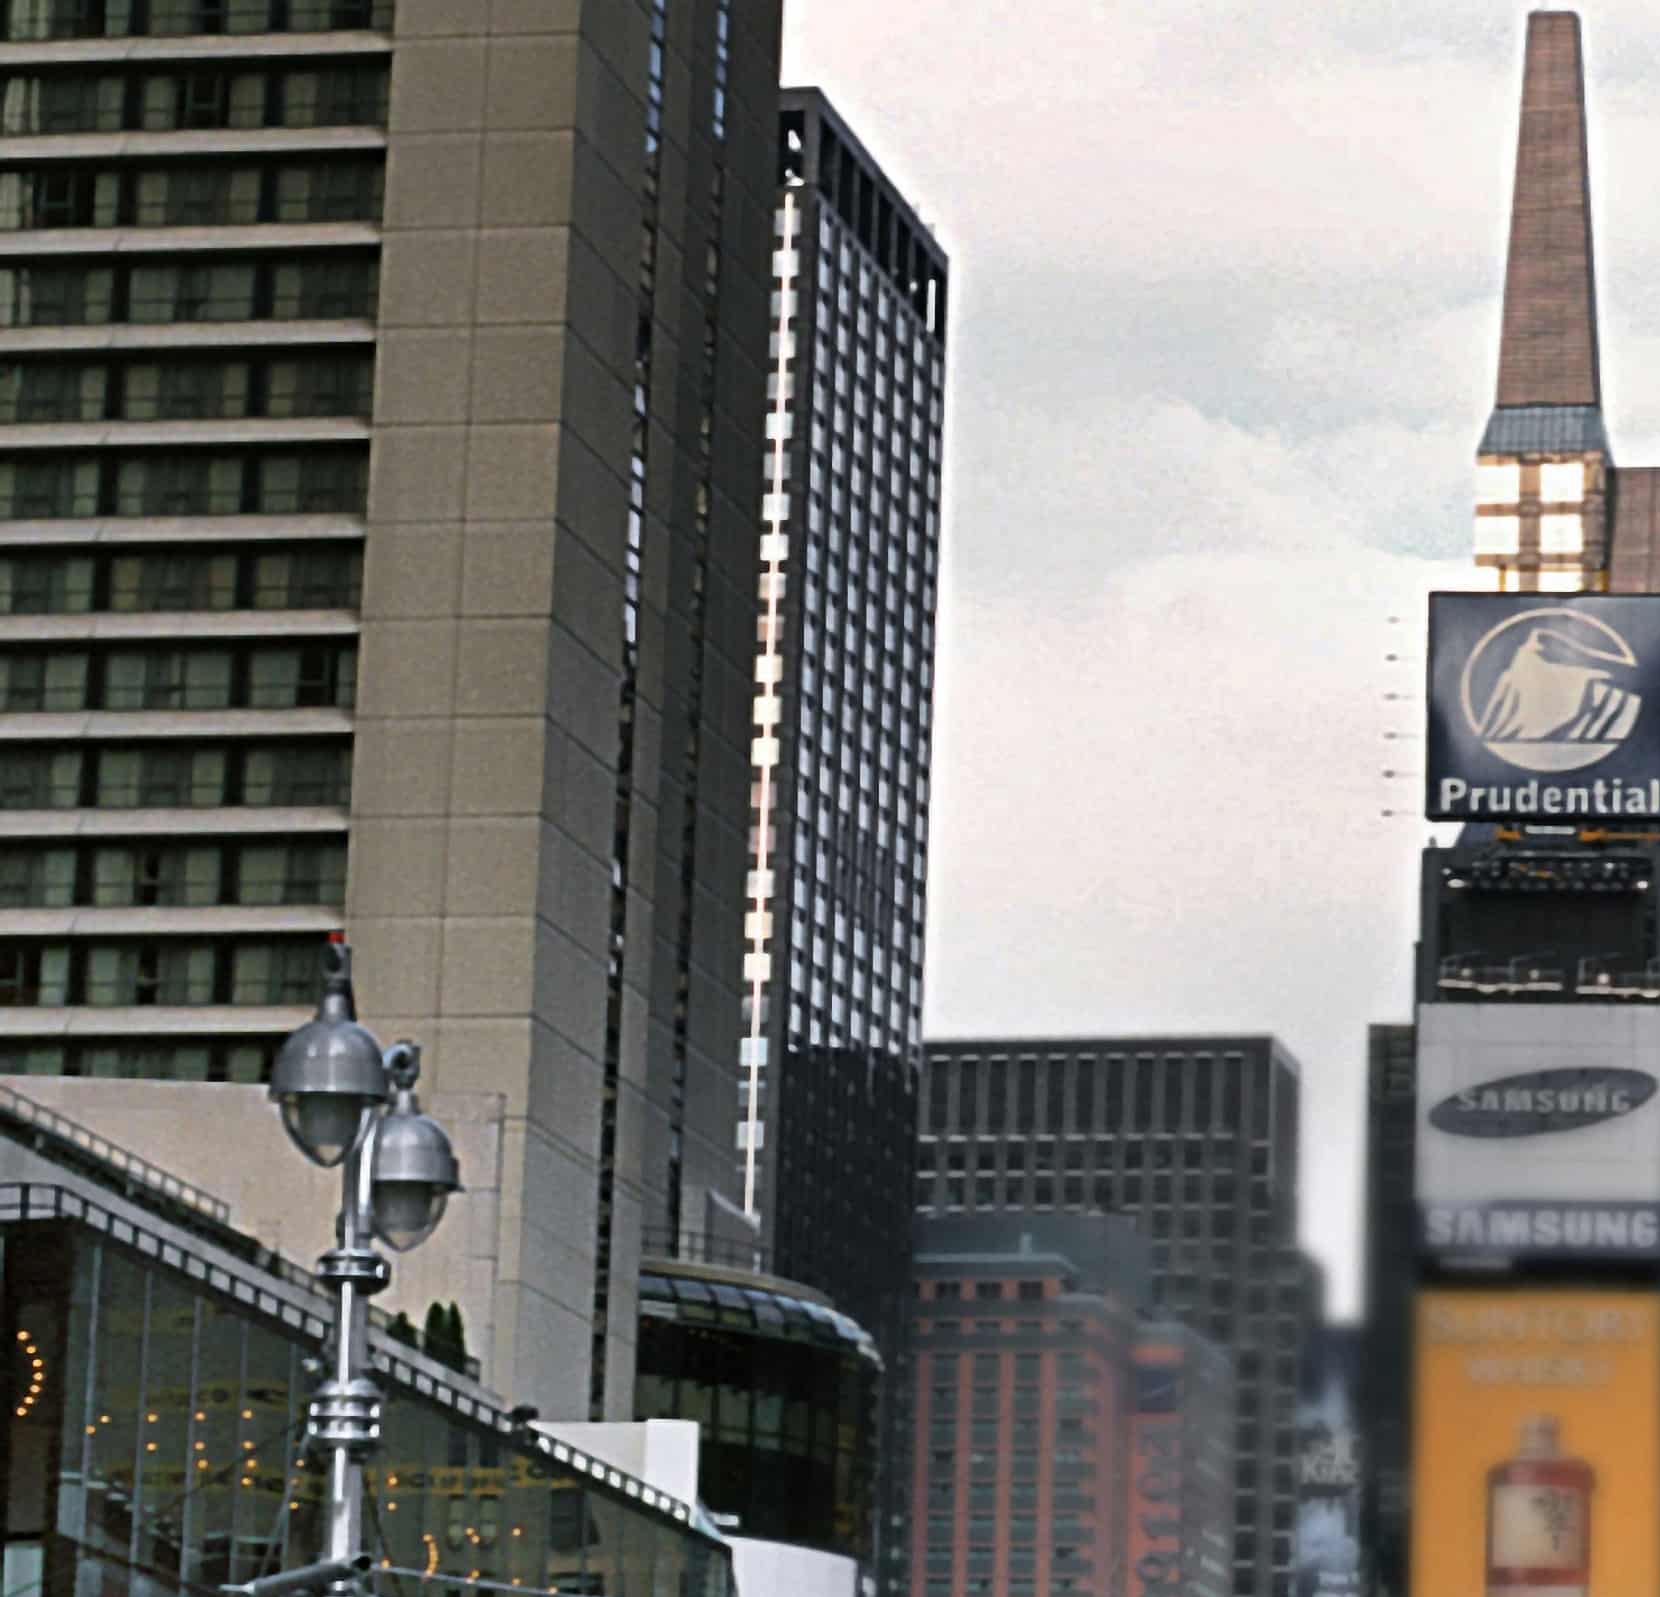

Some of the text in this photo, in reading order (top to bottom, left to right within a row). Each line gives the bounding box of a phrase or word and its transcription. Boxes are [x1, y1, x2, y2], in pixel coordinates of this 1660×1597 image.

[1440, 778, 1660, 813] Prudential
[1457, 1087, 1631, 1113] SAMSUNG
[1426, 1210, 1658, 1247] SAMSUNG
